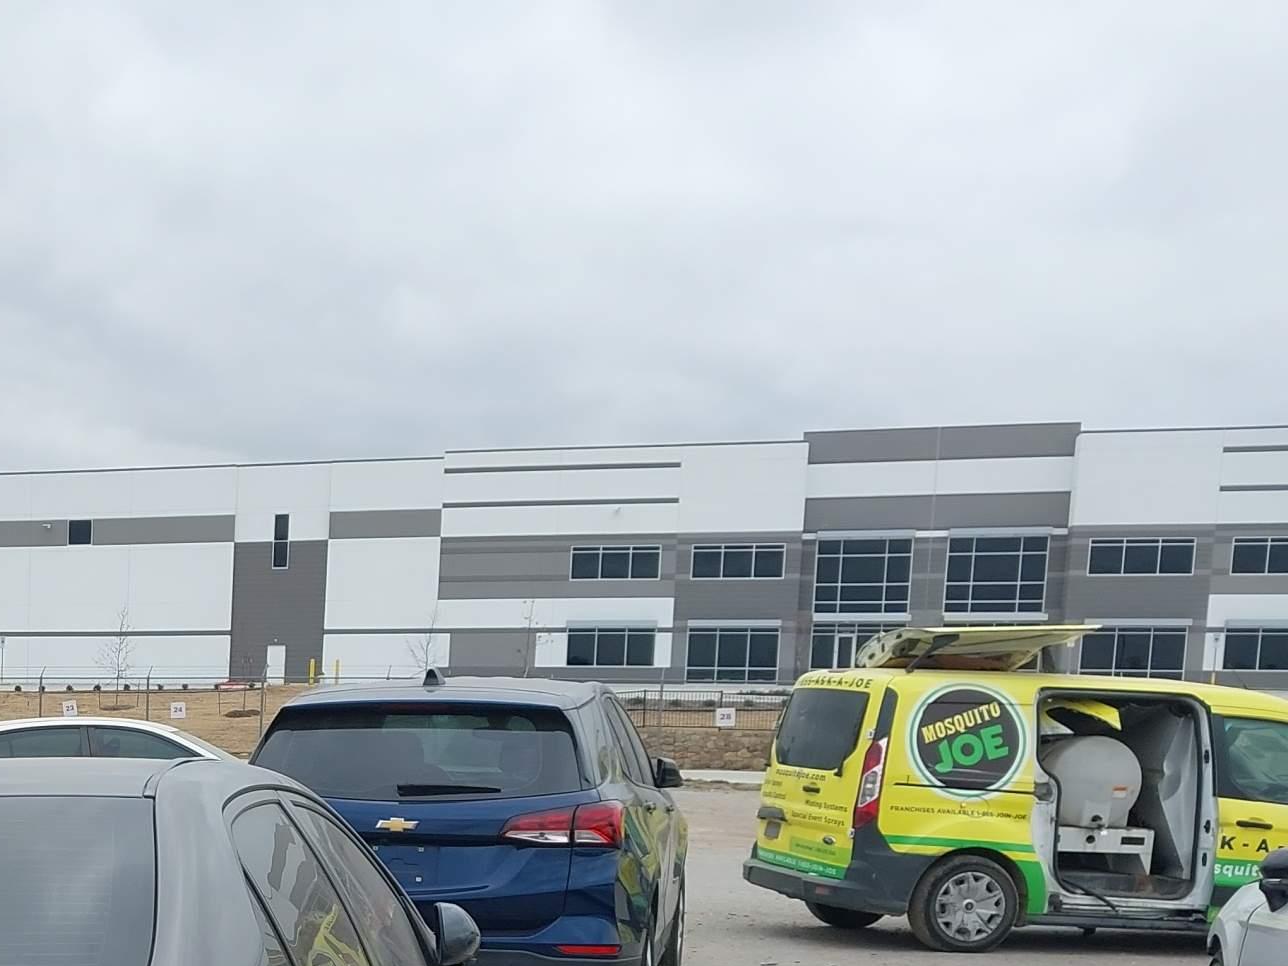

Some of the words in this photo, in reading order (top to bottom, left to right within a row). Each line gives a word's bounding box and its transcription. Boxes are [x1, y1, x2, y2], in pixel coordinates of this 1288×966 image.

[921, 701, 1001, 744] MOSQUITO
[935, 724, 1009, 773] JOE
[889, 805, 935, 814] FRANCHISES
